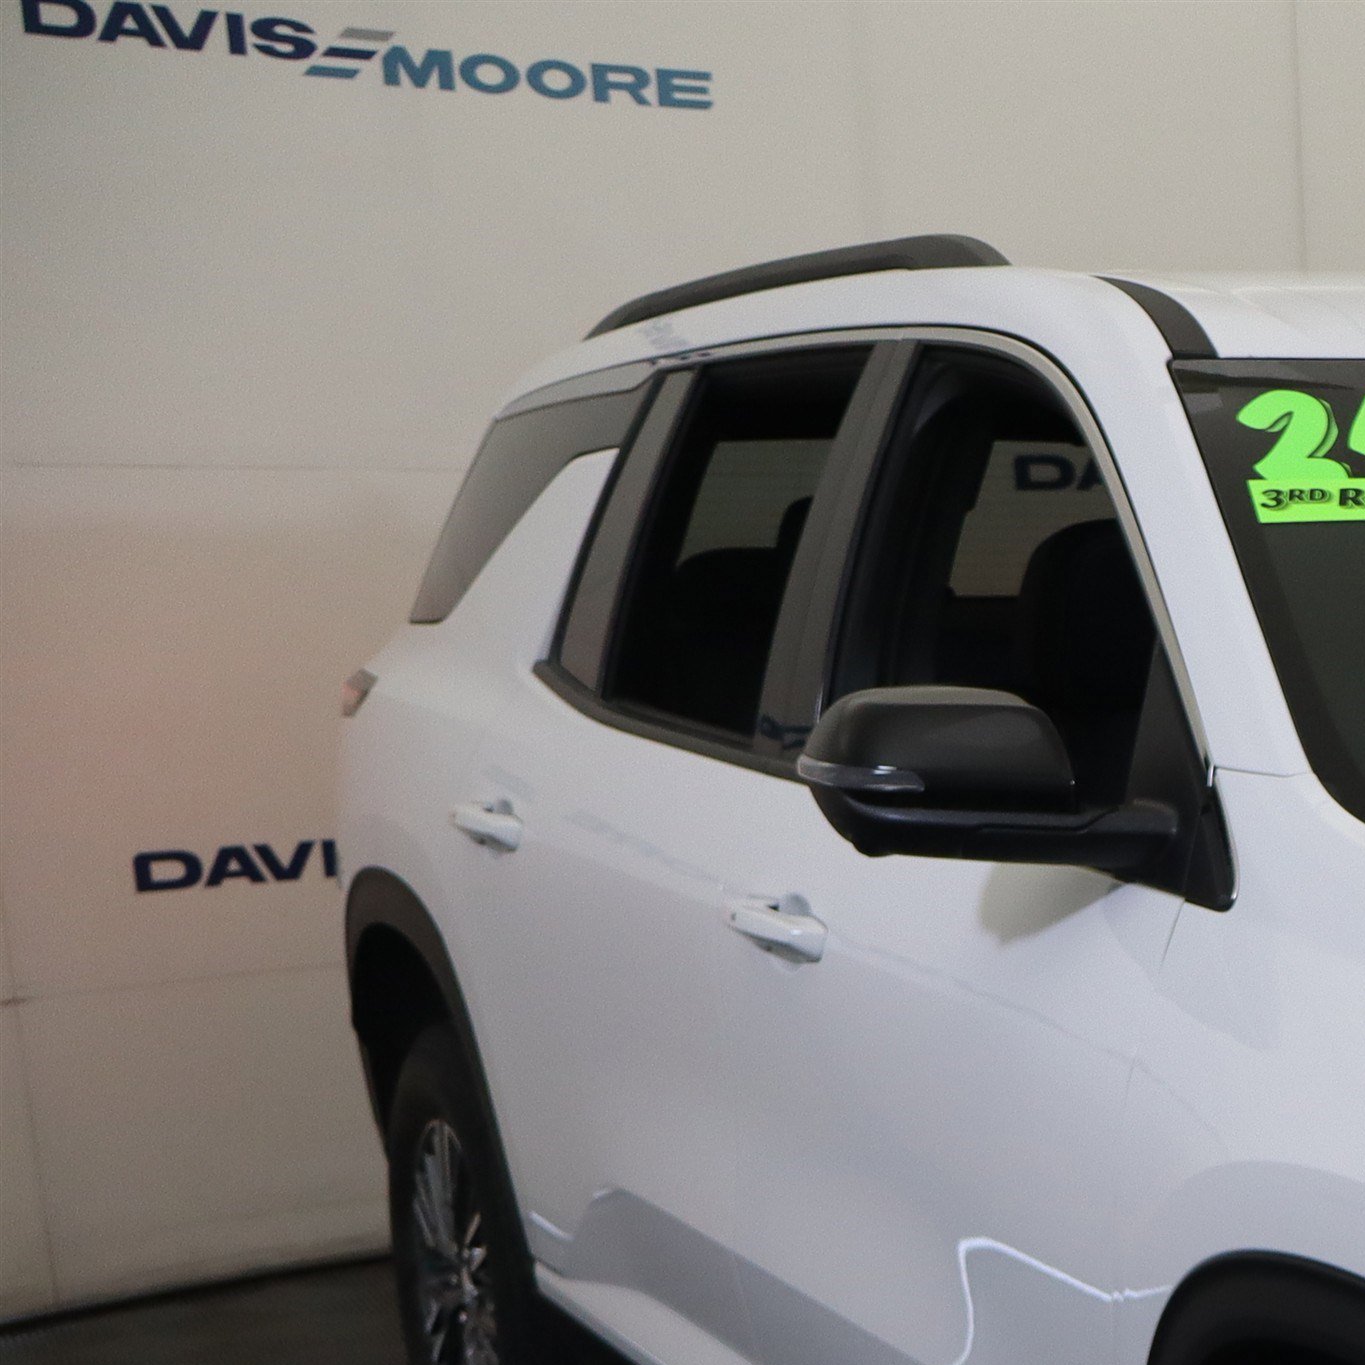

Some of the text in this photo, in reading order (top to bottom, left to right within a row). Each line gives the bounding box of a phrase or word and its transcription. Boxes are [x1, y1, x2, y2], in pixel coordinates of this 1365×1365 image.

[19, 0, 713, 110] DAVIS MOORE
[1259, 488, 1333, 511] 3RD
